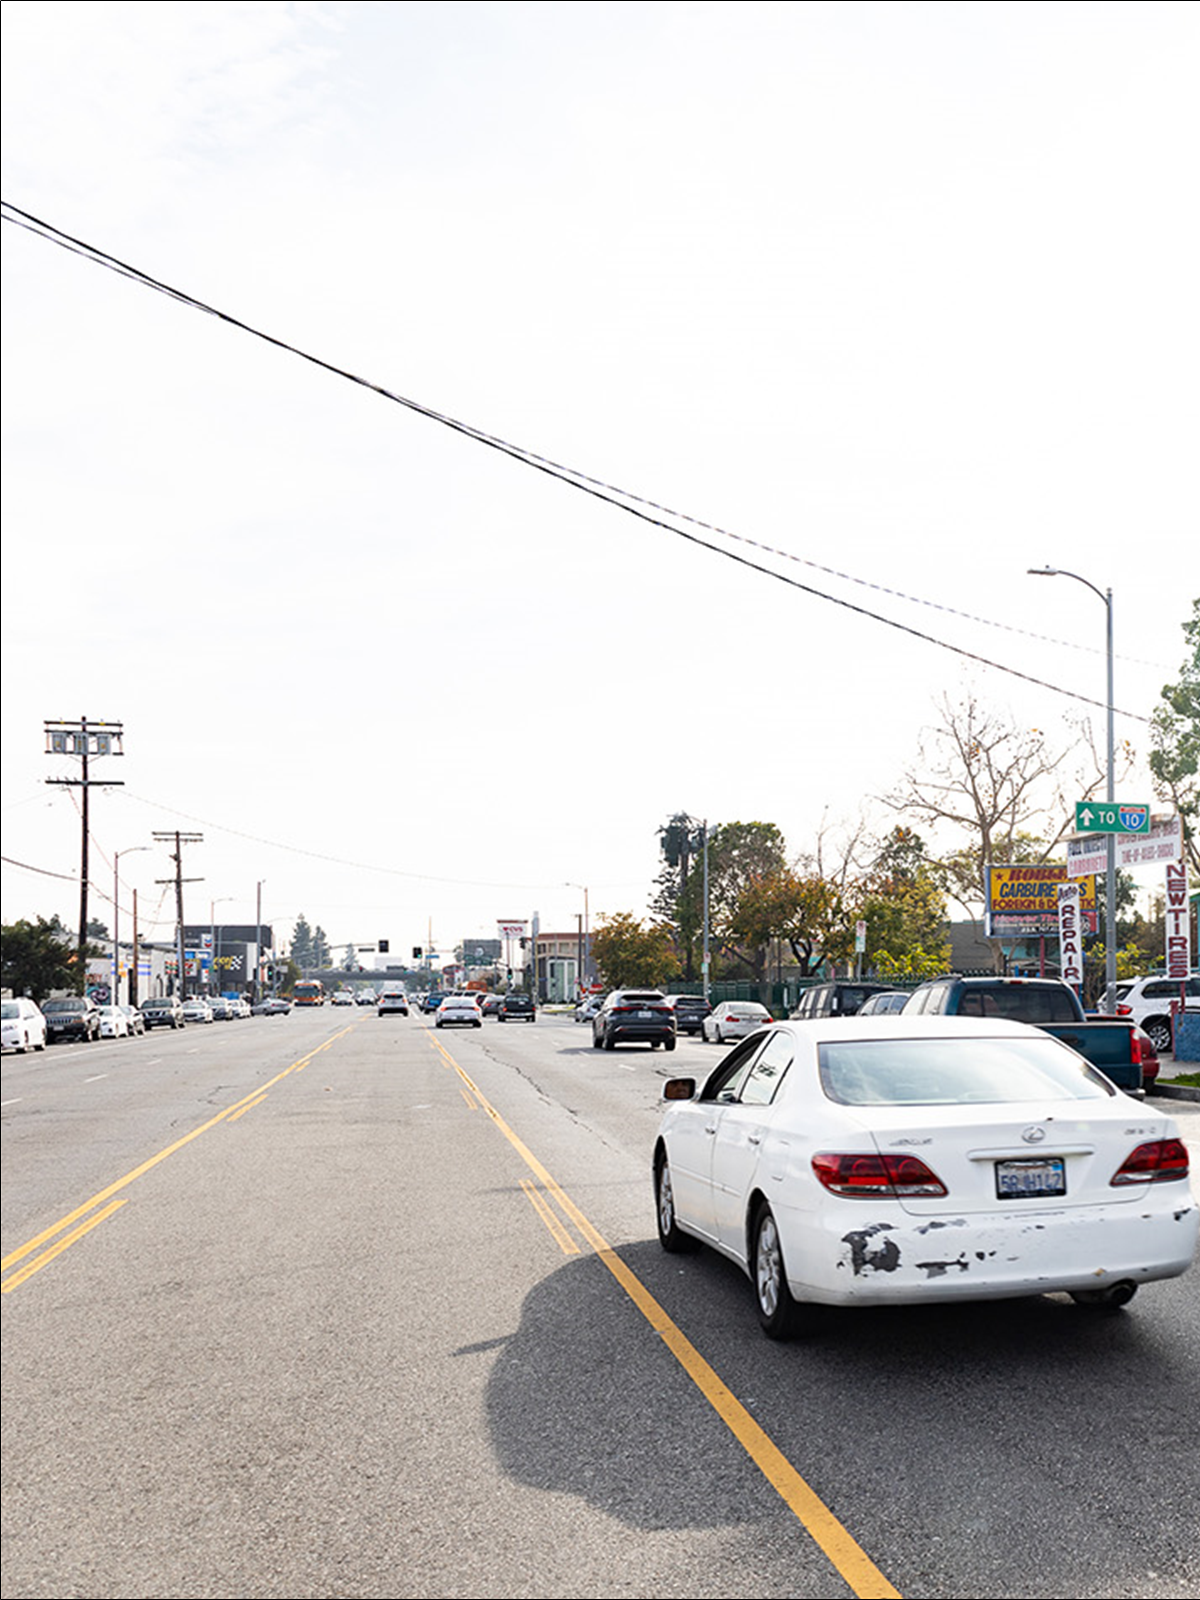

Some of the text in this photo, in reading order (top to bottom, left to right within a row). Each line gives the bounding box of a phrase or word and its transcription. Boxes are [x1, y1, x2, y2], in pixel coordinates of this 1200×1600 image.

[1099, 811, 1140, 827] TO 10
[1000, 882, 1088, 898] CARBURES
[1166, 864, 1187, 906] NEW
[993, 898, 1036, 910] FOREIGN
[1061, 904, 1080, 980] REPAIR
[1167, 908, 1189, 979] TIRES
